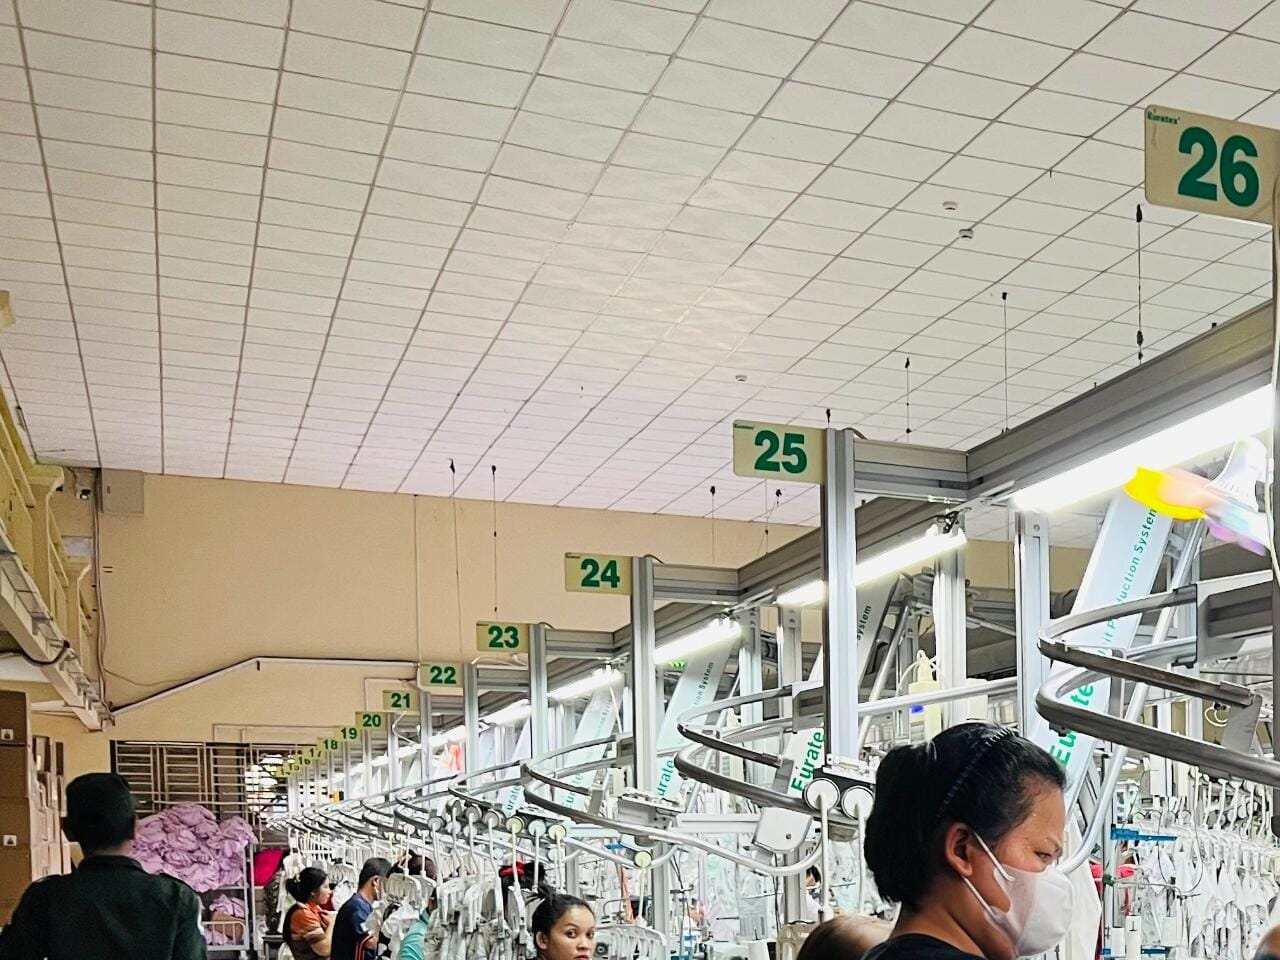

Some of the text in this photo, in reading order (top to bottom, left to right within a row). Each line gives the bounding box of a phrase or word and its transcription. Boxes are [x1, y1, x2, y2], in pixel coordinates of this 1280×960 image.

[1177, 126, 1260, 208] 26
[754, 430, 808, 475] 25
[580, 558, 621, 589] 24
[488, 625, 519, 648] 23
[430, 666, 456, 684] 22
[391, 692, 411, 708] 21
[362, 714, 382, 727] 20
[341, 727, 358, 739] 19
[323, 739, 338, 750] 18
[791, 730, 825, 792] Eurate
